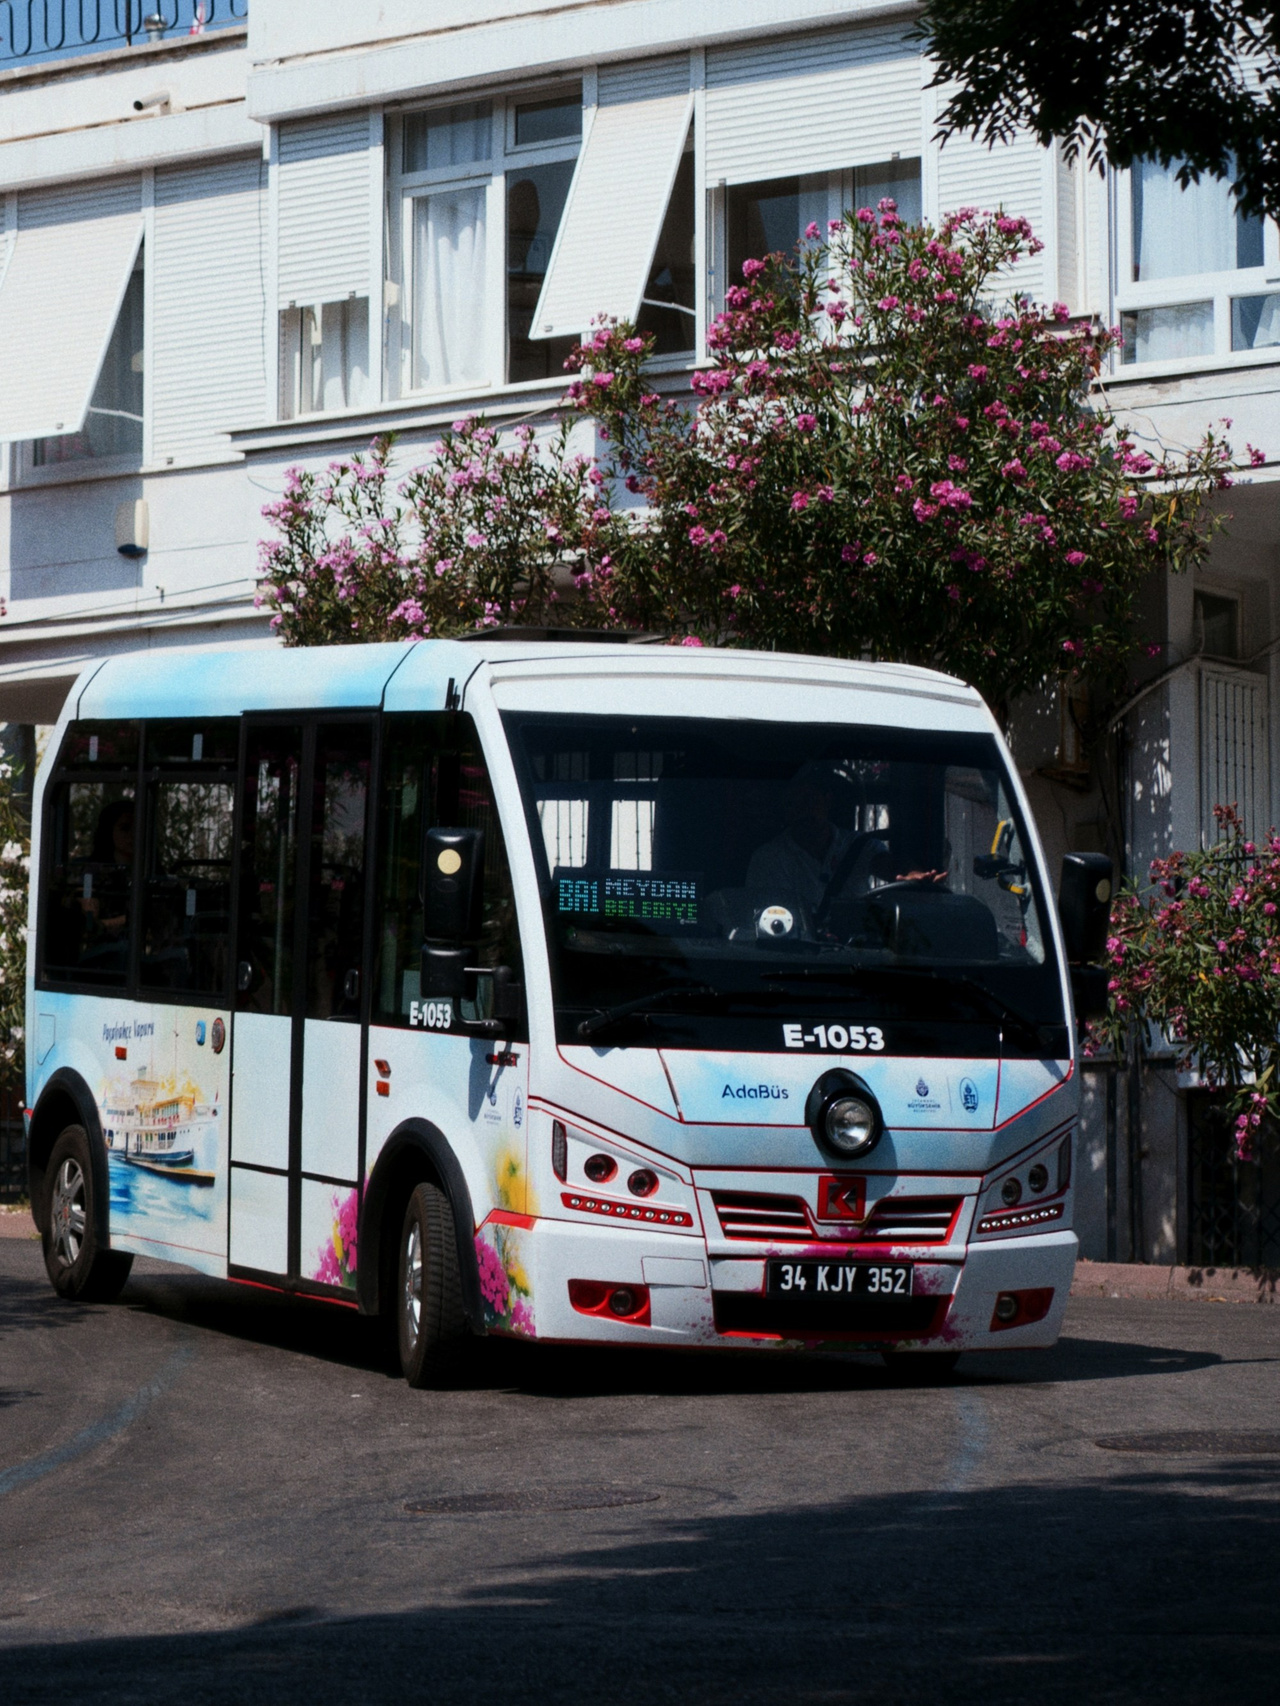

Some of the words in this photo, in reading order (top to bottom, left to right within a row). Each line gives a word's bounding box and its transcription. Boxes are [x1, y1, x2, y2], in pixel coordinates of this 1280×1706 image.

[605, 878, 696, 899] MEYDAN
[409, 1001, 451, 1029] E-1053
[782, 1023, 885, 1051] E-1053
[721, 1084, 789, 1100] AdaBüs
[780, 1264, 807, 1291] 34
[816, 1265, 857, 1293] KJY
[867, 1267, 907, 1294] 352
